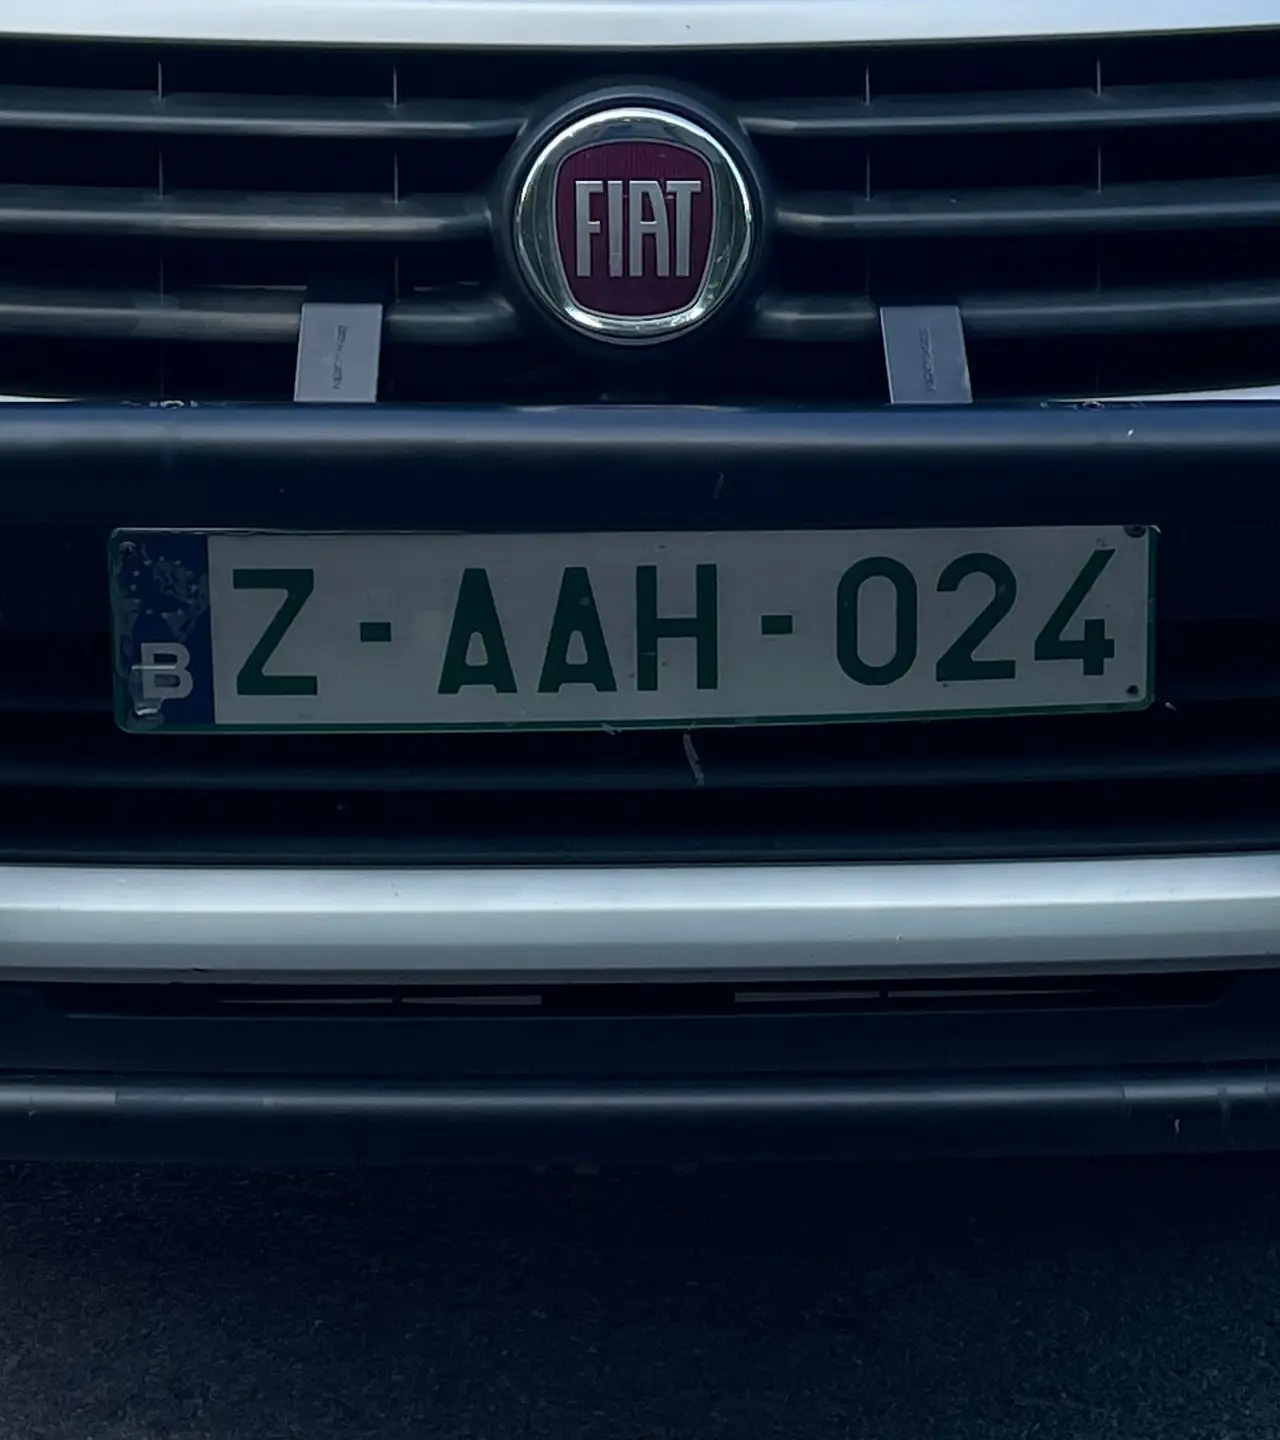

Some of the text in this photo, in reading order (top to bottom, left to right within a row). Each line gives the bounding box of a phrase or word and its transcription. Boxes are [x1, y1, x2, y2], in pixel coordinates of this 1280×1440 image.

[575, 180, 702, 278] FIAT
[140, 642, 194, 699] B
[233, 548, 1117, 696] Z-AAH-024
